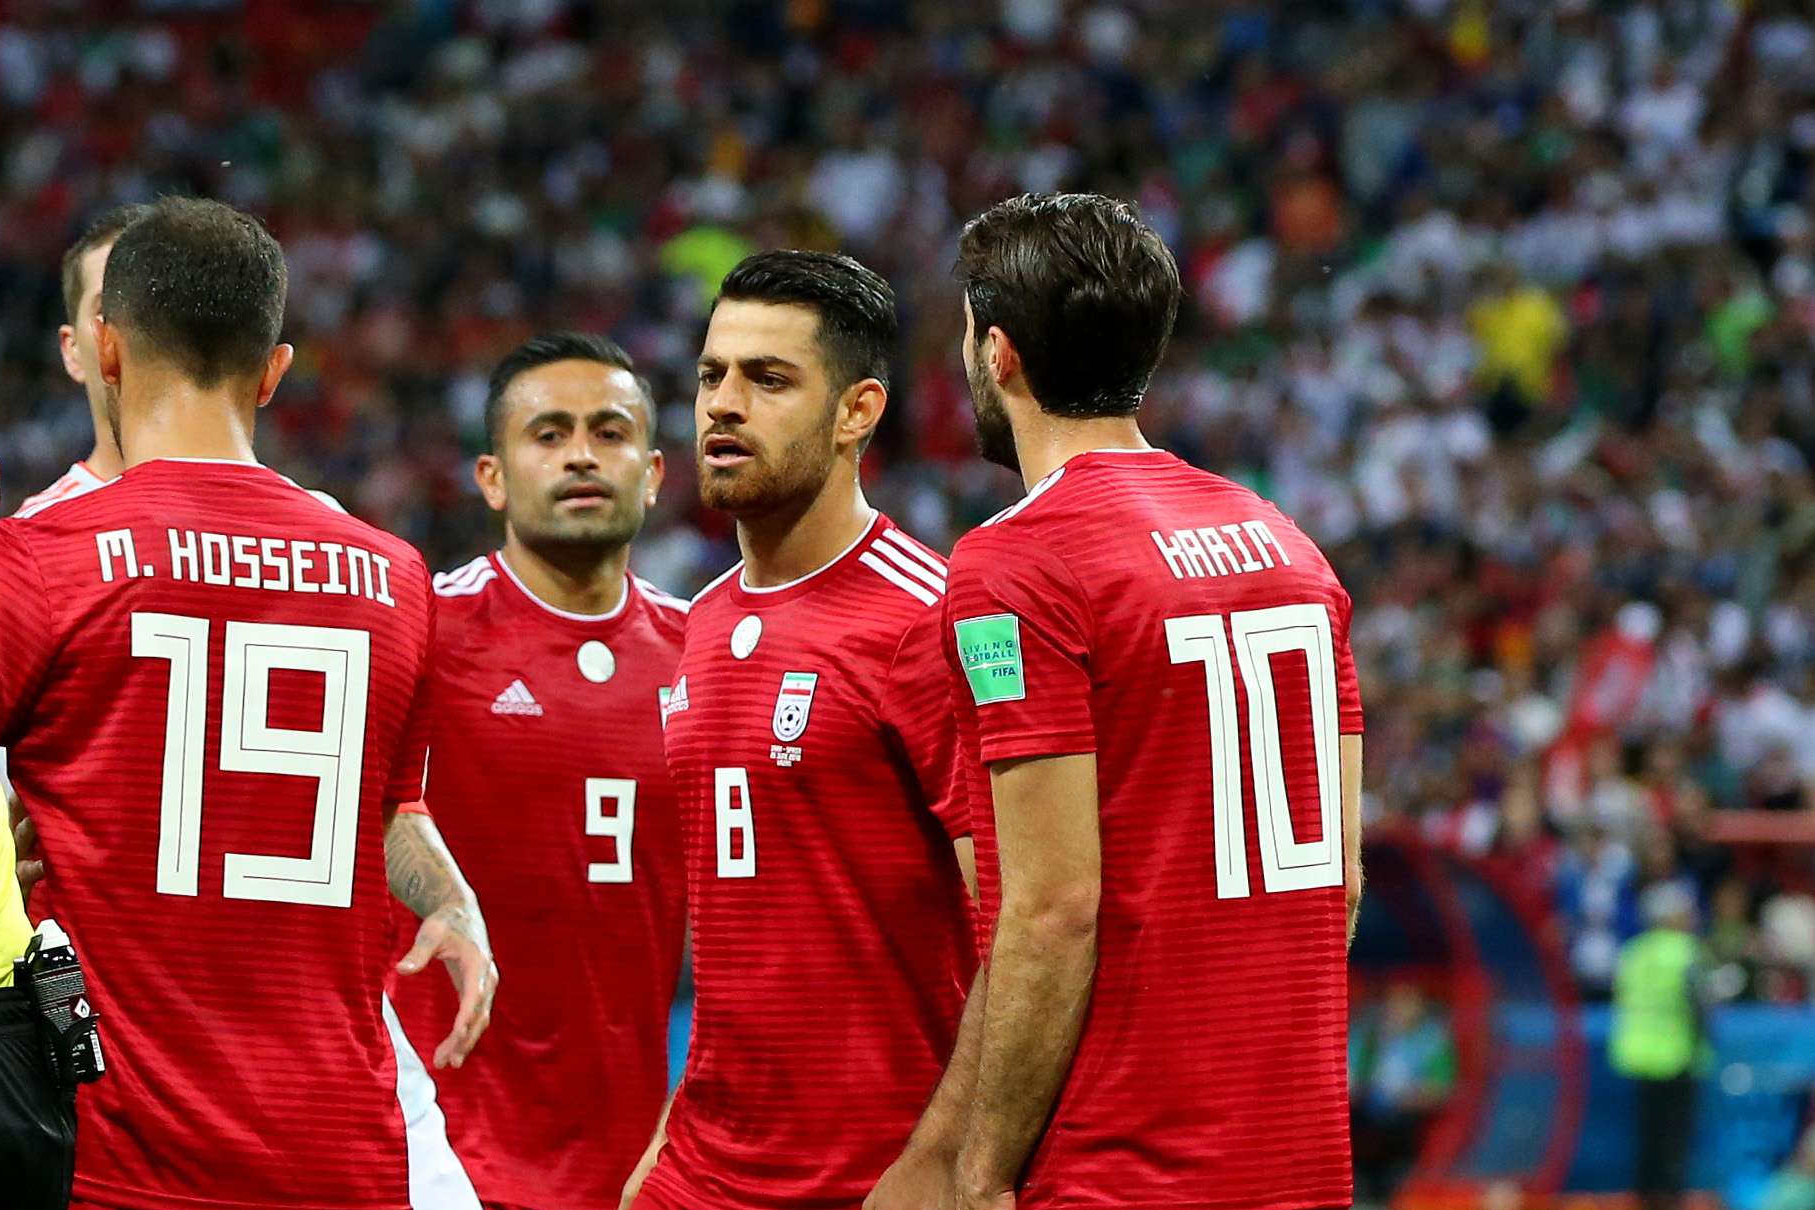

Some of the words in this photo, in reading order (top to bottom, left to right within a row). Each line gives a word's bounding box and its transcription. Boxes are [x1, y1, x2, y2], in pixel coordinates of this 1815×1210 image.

[96, 528, 155, 582] M.
[167, 528, 395, 608] HOSSEINI
[1151, 520, 1290, 579] KARIM
[963, 640, 1014, 655] LIVING
[992, 667, 1016, 677] FIFA
[131, 612, 370, 908] 19
[1164, 604, 1343, 899] 10
[585, 777, 637, 883] 9
[715, 767, 755, 877] 8
